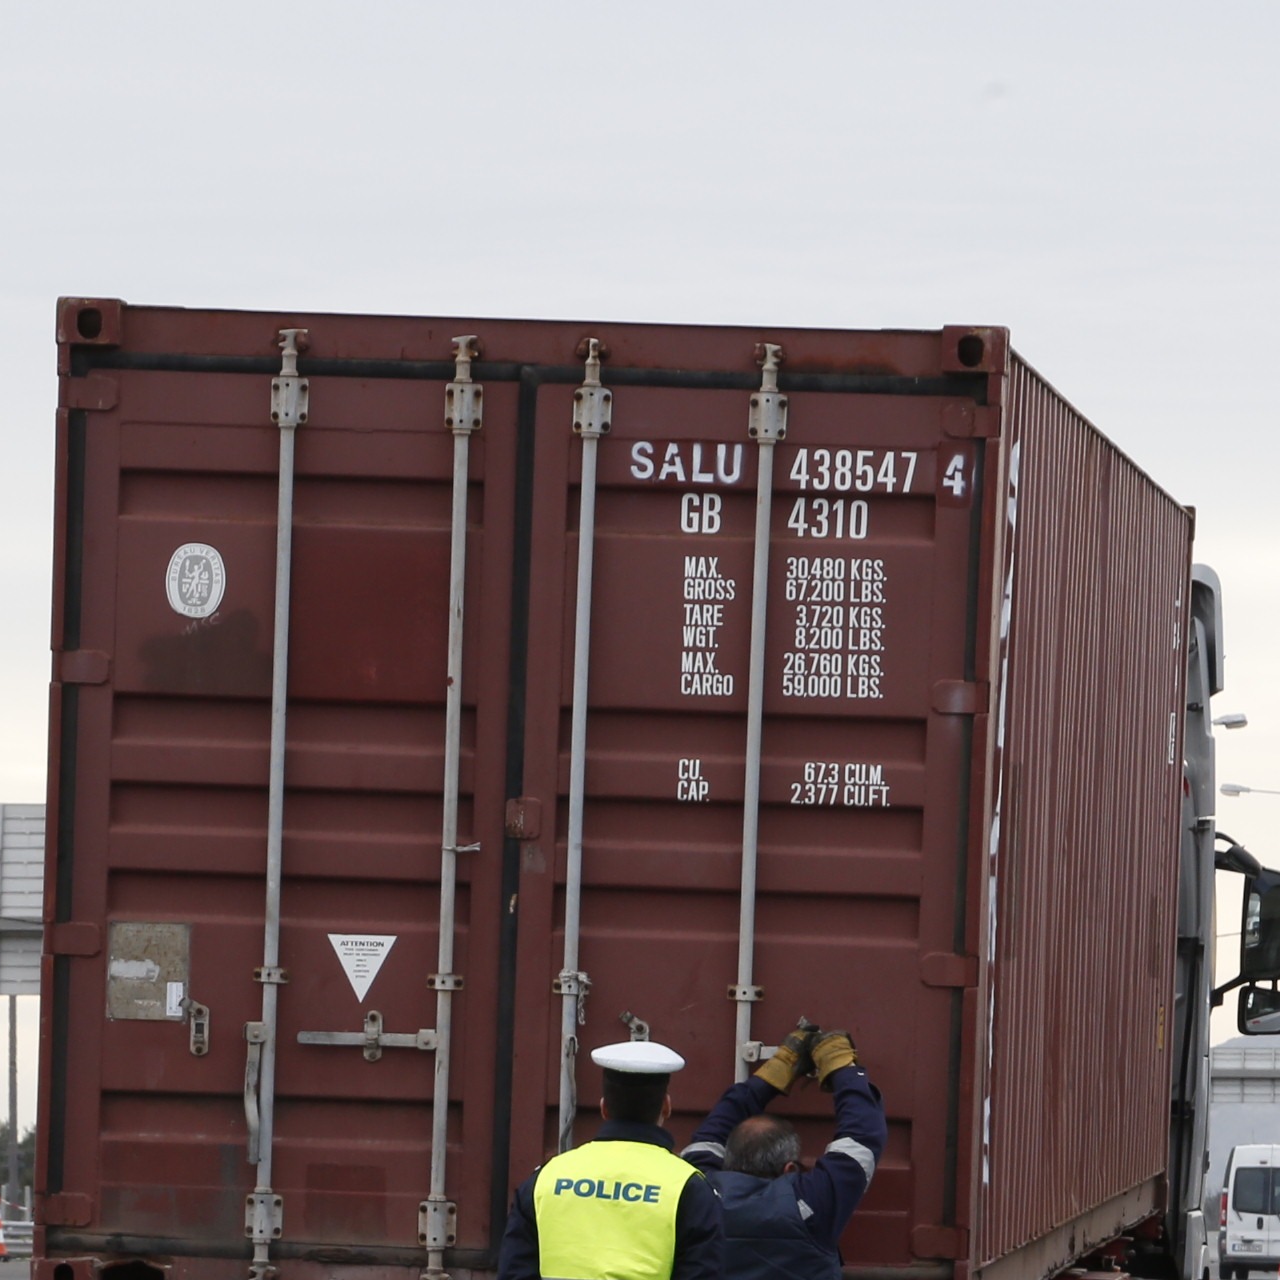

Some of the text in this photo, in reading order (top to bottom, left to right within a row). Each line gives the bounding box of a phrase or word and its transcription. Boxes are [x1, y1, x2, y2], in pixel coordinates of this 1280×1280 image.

[631, 442, 964, 495] SALU 438547 4
[681, 494, 867, 539] GB 4310
[685, 557, 887, 581] MAX. 30,480 KGS.
[684, 579, 886, 603] GROSS 67,200 LBS.
[684, 604, 885, 628] TARE 3,720 KGS.
[683, 627, 884, 650] WGT. 8,200 LBS.
[682, 652, 883, 676] MAX. 26,760 KGS.
[681, 675, 883, 698] CARGO 59,000 LBS.
[679, 759, 884, 785] CU. 67.3 CU.M.
[677, 781, 889, 806] CAP. 2,377 CU.FT.
[554, 1178, 661, 1203] POLICE
